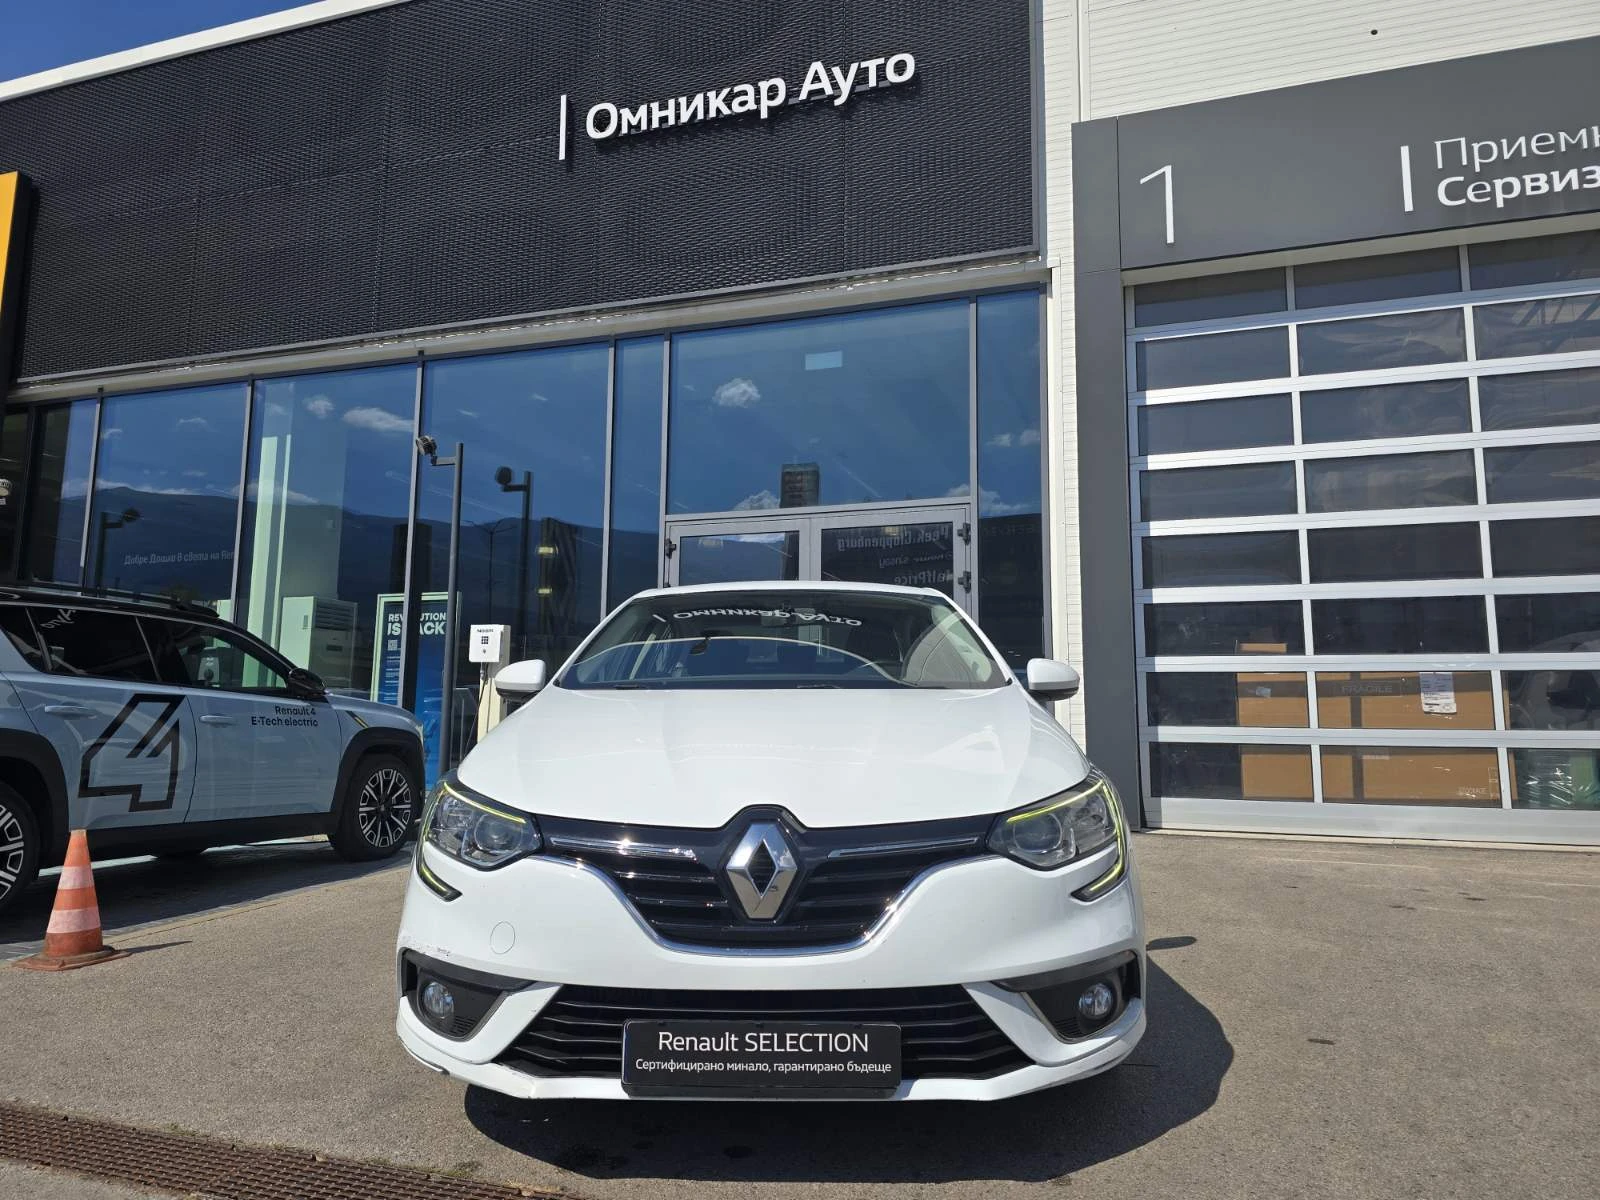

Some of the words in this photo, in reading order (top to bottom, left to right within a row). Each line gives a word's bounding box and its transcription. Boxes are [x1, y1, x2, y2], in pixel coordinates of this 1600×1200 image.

[585, 77, 787, 140] Омникар
[799, 53, 915, 107] Ауто
[1437, 165, 1600, 208] Сервиз
[1140, 164, 1175, 245] 1
[251, 716, 283, 727] E-Tech
[284, 717, 318, 727] electric
[275, 705, 310, 716] Renault
[658, 1031, 739, 1052] Renault
[744, 1033, 869, 1053] SELECTION
[635, 1058, 725, 1072] Сертифицирано
[726, 1061, 772, 1073] минало,
[773, 1062, 845, 1073] гарантирано
[846, 1060, 892, 1073] бъдеще
